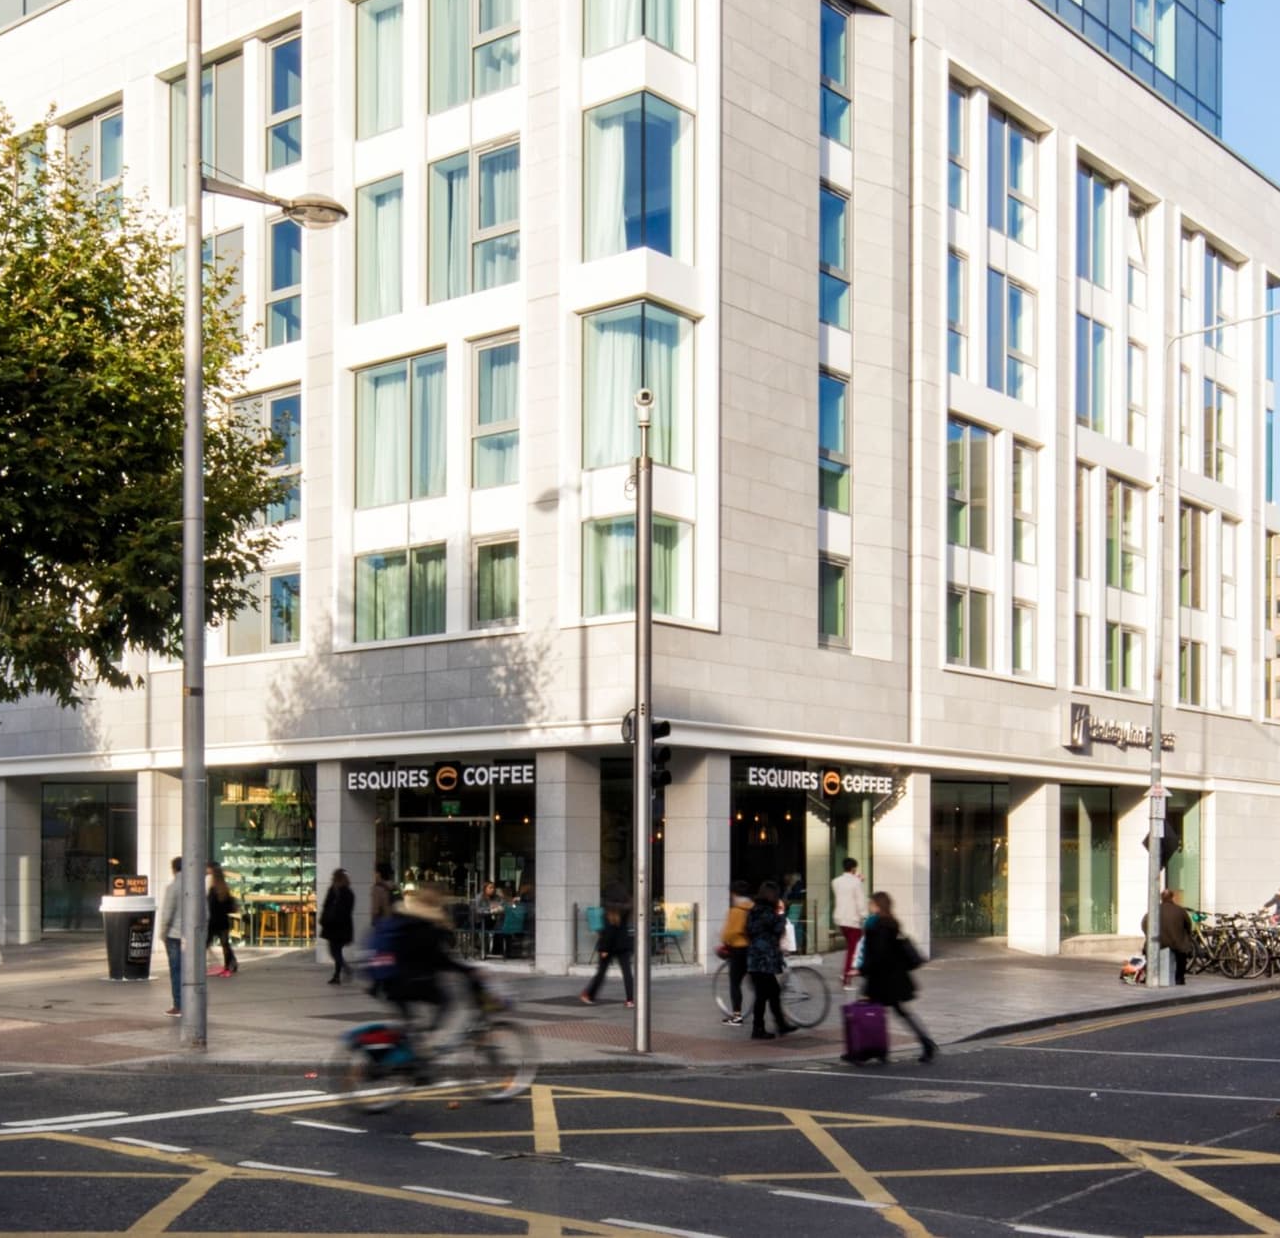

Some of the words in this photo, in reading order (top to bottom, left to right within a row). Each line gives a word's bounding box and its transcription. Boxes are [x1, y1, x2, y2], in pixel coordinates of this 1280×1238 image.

[1089, 715, 1127, 746] Holiday
[347, 769, 429, 790] ESQUIRES
[463, 765, 534, 786] COFFEE
[748, 767, 819, 790] ESQUIRES
[842, 774, 893, 794] COFFEE
